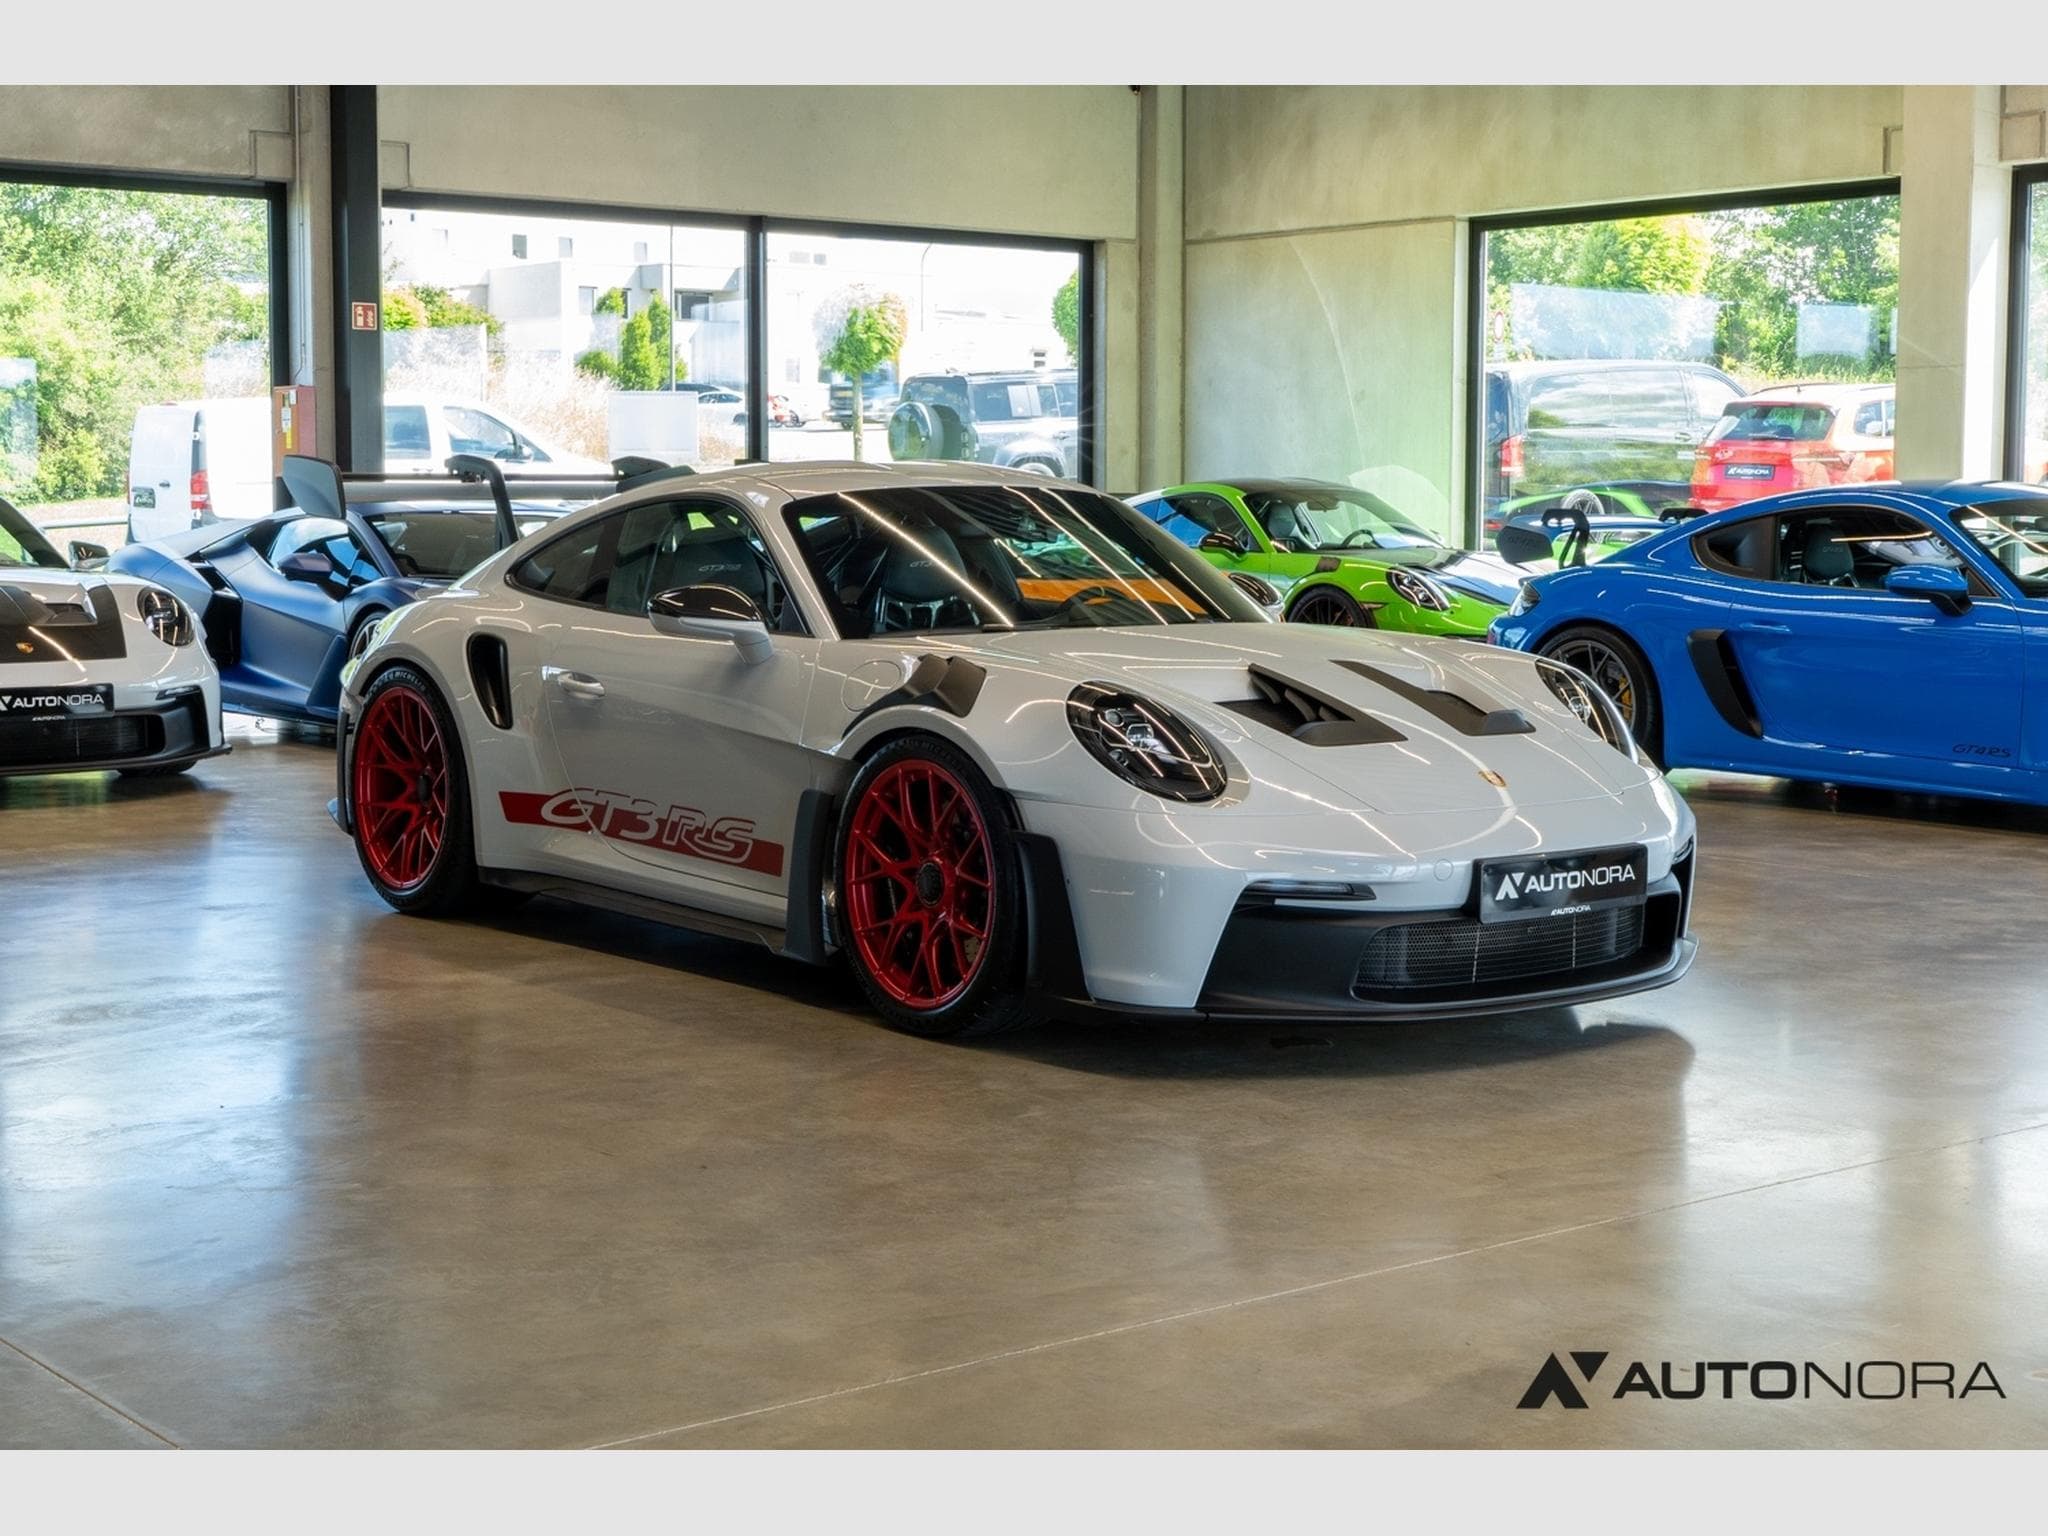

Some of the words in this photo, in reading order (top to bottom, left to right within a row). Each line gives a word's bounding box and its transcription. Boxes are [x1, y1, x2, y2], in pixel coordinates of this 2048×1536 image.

[12, 694, 104, 708] AUTONORA
[1524, 863, 1636, 894] AUTONORA
[1556, 904, 1591, 915] AUTONORA
